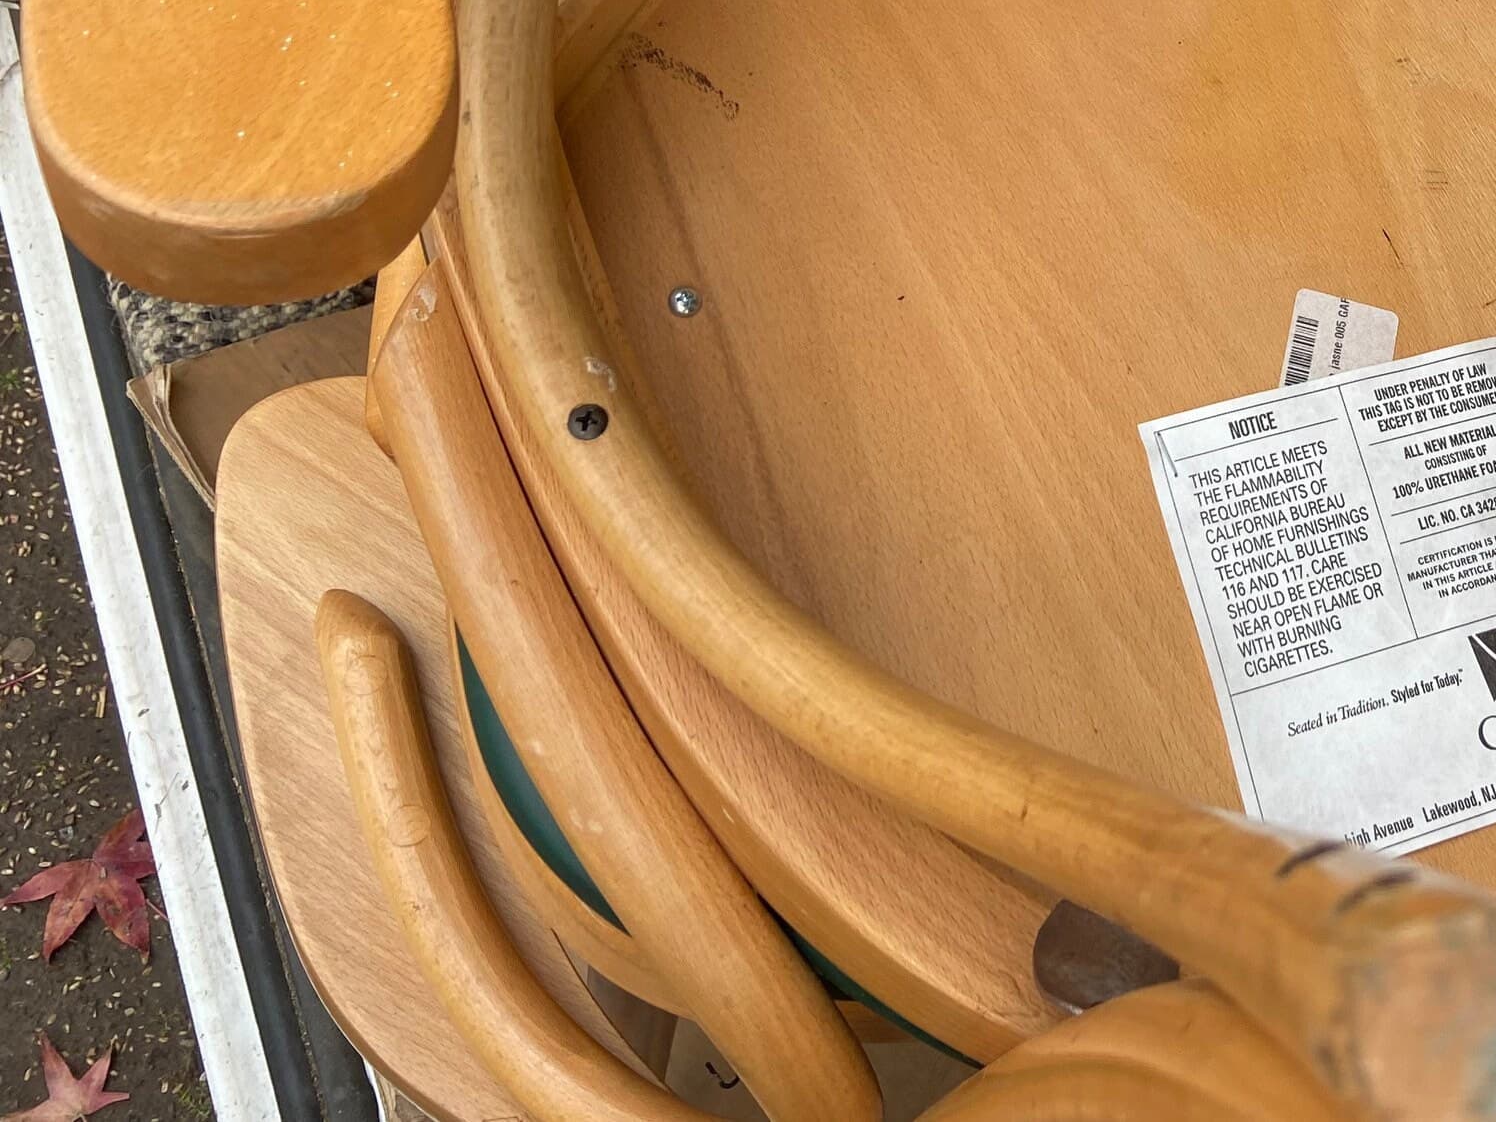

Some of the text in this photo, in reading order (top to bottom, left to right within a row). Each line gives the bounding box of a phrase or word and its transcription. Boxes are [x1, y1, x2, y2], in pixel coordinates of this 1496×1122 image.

[1335, 321, 1347, 339] 005
[1373, 362, 1486, 401] UNDER PENALTY OF LAW
[1358, 404, 1383, 421] THIS
[1382, 399, 1402, 414] TAG
[1403, 396, 1415, 410] IS
[1415, 391, 1435, 407] NOT
[1435, 388, 1449, 402] TO
[1450, 384, 1465, 398] BE
[1377, 412, 1413, 432] EXCEPT
[1414, 408, 1427, 423] BY
[1428, 403, 1449, 419] THE
[1228, 411, 1277, 440] NOTICE
[1188, 440, 1327, 488] THIS ARTICLE MEETS
[1403, 443, 1424, 459] ALL
[1423, 436, 1447, 454] NEW
[1424, 444, 1486, 470] CONSISTING OF
[1193, 459, 1322, 506] THE FLAMMABILITY
[1392, 480, 1424, 499] 100%
[1424, 465, 1479, 490] URETHANE
[1199, 477, 1327, 526] REQUIREMENTS OF
[1205, 493, 1345, 544] CALIFORNIA BUREAU
[1417, 514, 1439, 530] LIC.
[1439, 509, 1459, 524] NO.
[1460, 504, 1475, 518] CA
[1211, 506, 1369, 562] OF HOME FURNISHINGS
[1417, 540, 1483, 565] CERTIFICATION
[1483, 537, 1493, 547] IS
[1214, 526, 1368, 581] TECHNICAL BULLETINS
[1407, 554, 1478, 582] MANUFACTURER
[1222, 551, 1348, 600] 116 AND 117. CARE
[1227, 562, 1382, 619] SHOULD BE EXERCISED
[1422, 580, 1433, 590] IN
[1434, 573, 1455, 586] THIS
[1458, 562, 1494, 580] ARTICLE
[1438, 588, 1449, 598] IN
[1232, 582, 1384, 639] NEAR OPEN FLAME OR
[1237, 614, 1341, 658] WITH BURNING
[1244, 639, 1333, 677] CIGARETTES.
[1287, 712, 1323, 736] Seated
[1326, 711, 1337, 725] in
[1337, 697, 1389, 720] Tradition.
[1390, 682, 1420, 703] Styled
[1420, 680, 1434, 694] for
[1345, 828, 1371, 847] high
[1373, 817, 1414, 840] Avenue
[1422, 790, 1481, 822] Lakewood,
[1480, 783, 1496, 803] NJ
